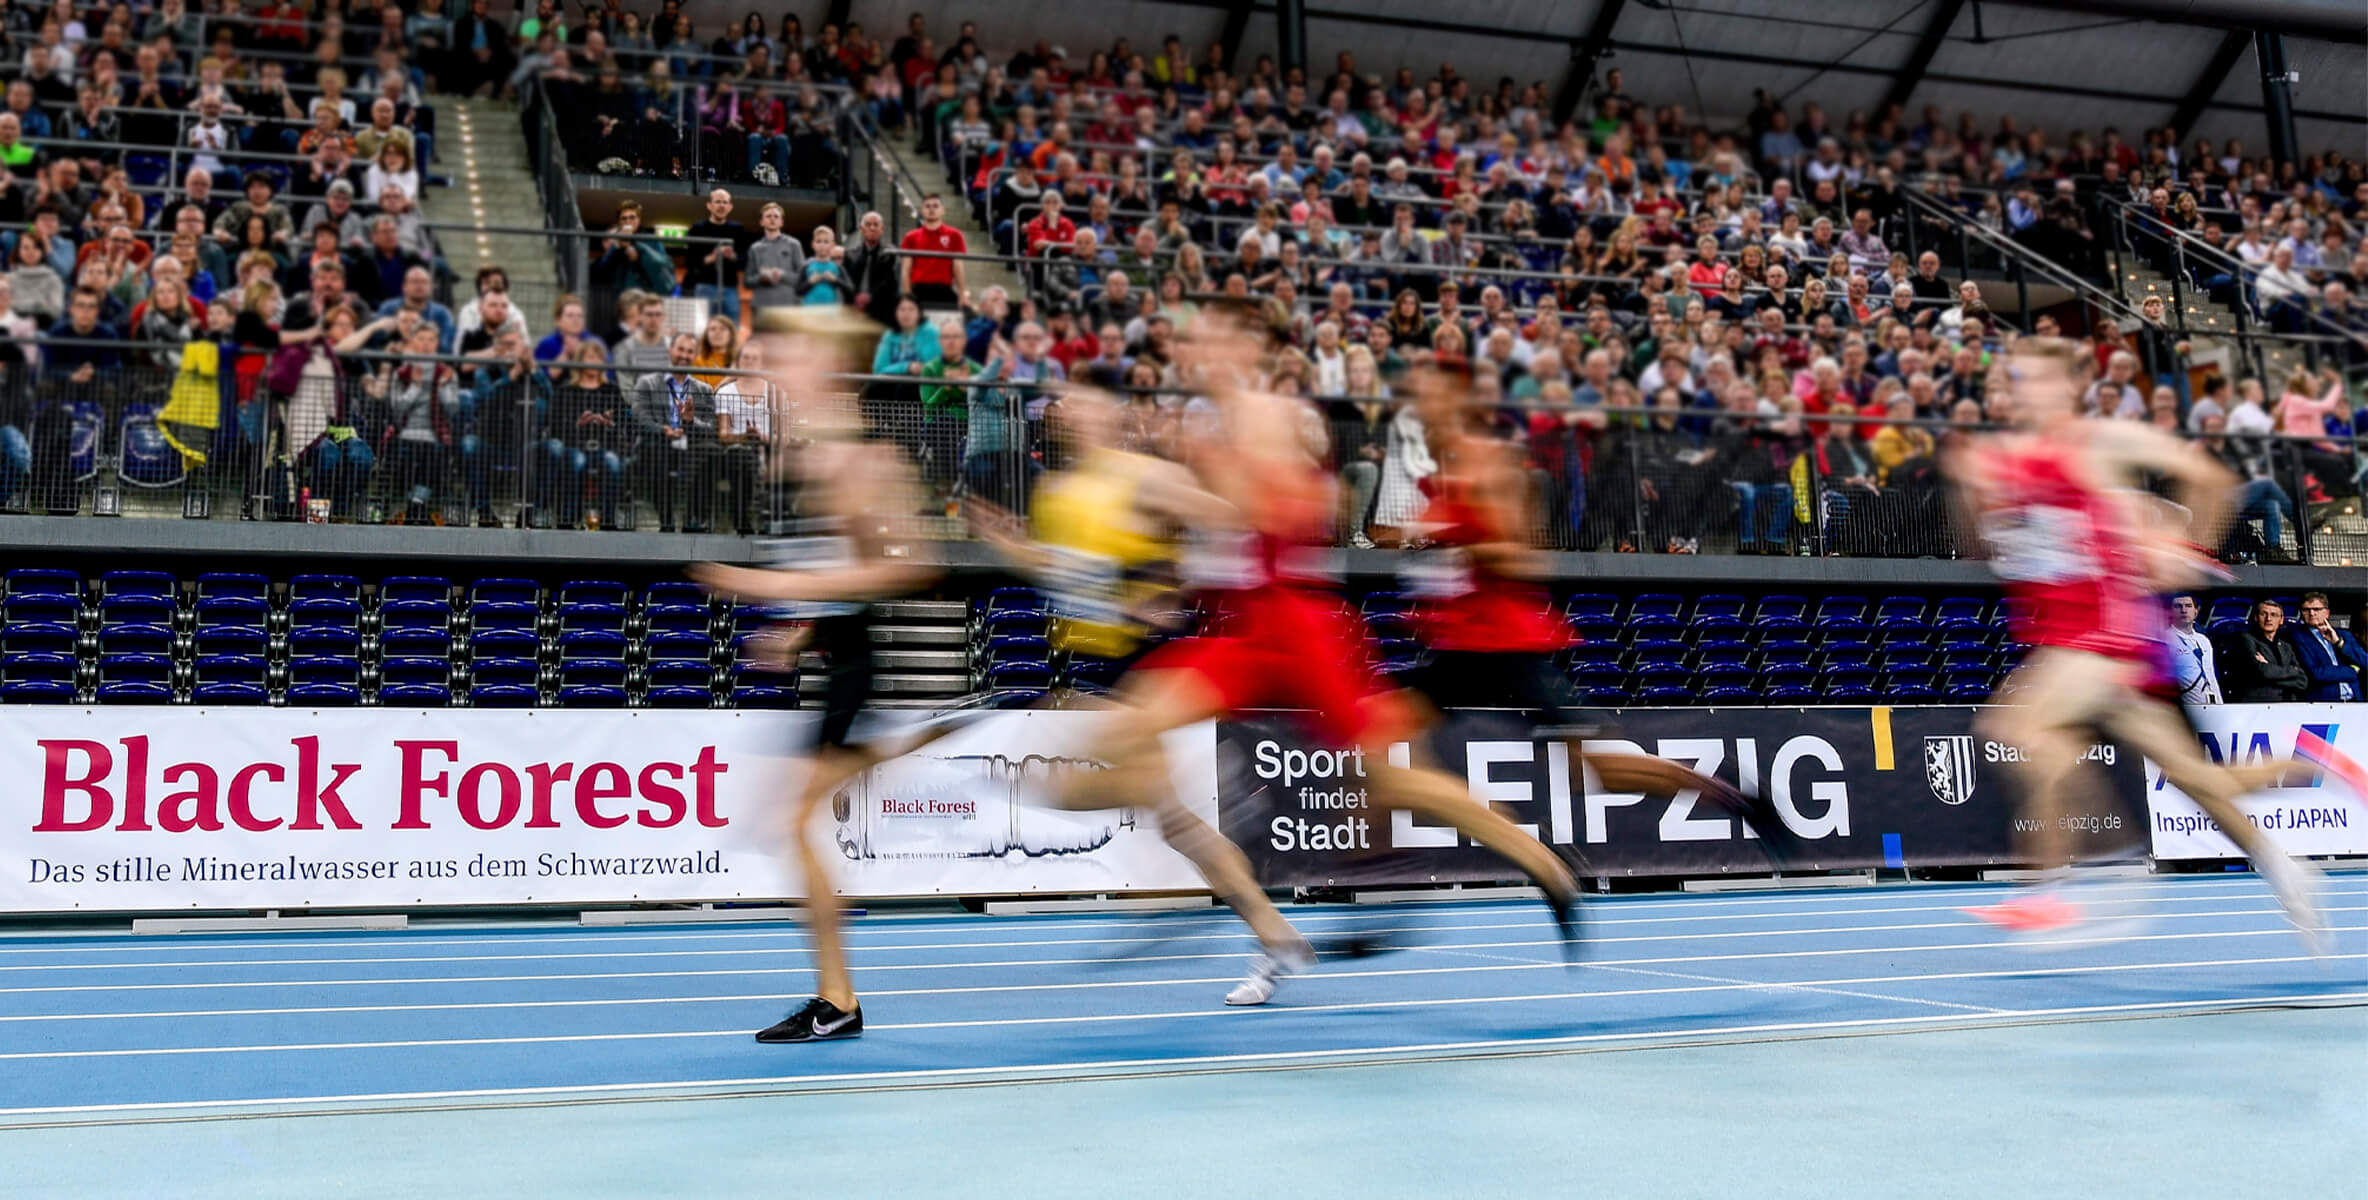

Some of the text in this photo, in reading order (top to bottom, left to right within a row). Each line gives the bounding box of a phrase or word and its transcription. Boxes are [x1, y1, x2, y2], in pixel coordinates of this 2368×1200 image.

[1255, 740, 1367, 787] Sport
[31, 734, 730, 833] Black Forest
[1299, 786, 1368, 810] findet
[1387, 735, 1851, 848] LEIPZIG
[882, 799, 977, 814] Black Forest
[2156, 807, 2348, 836] Inspiran of JAPAN
[1270, 816, 1370, 851] Stadt
[29, 849, 729, 883] Das stille Mineralwasser aus dem Schwarzwald.
